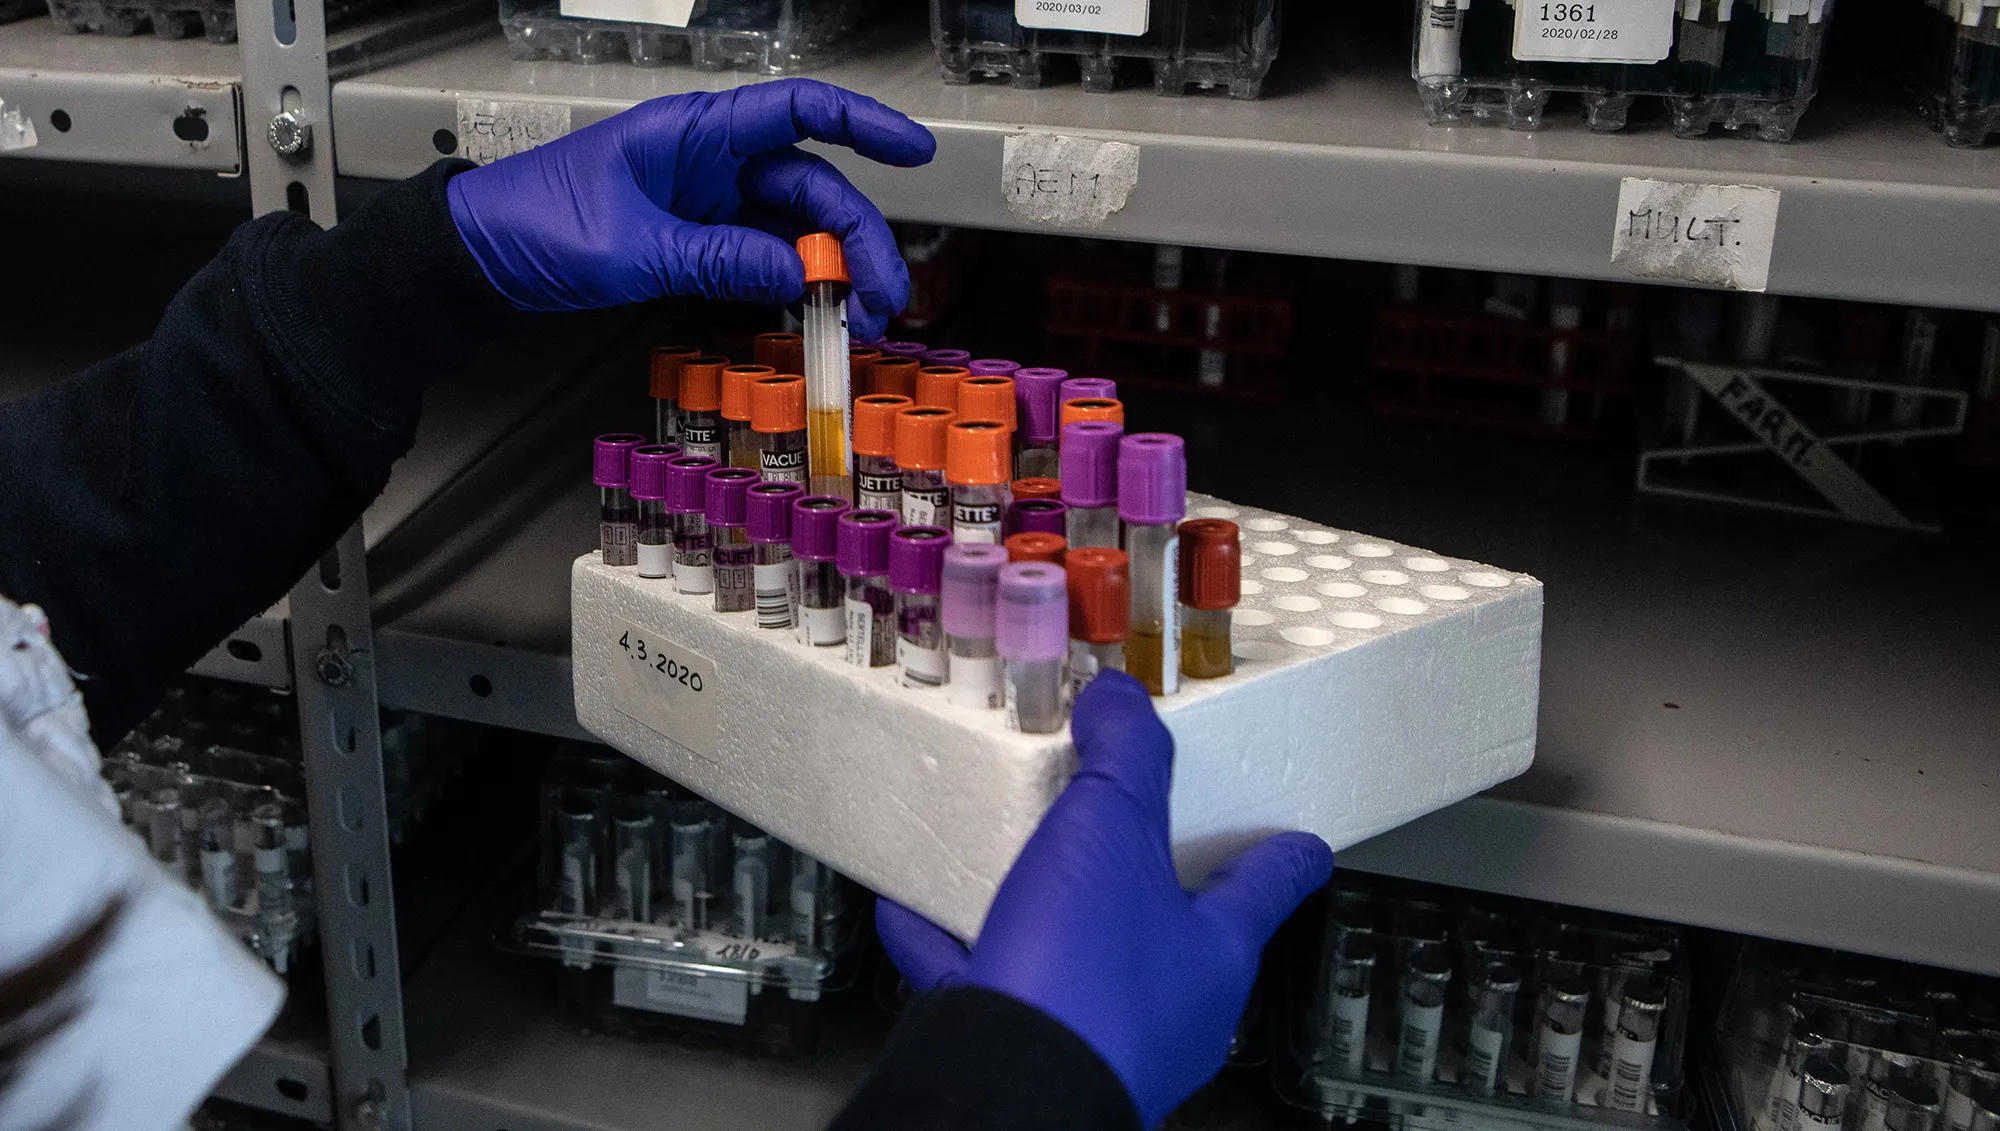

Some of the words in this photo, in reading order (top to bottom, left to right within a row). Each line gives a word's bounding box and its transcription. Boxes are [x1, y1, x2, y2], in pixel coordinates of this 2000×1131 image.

[1036, 2, 1101, 15] 2020/03/02
[1540, 3, 1596, 22] 1361
[1542, 28, 1619, 40] 2020/02/28
[1629, 209, 1740, 247] MULT.
[619, 630, 703, 692] 4.3.2020
